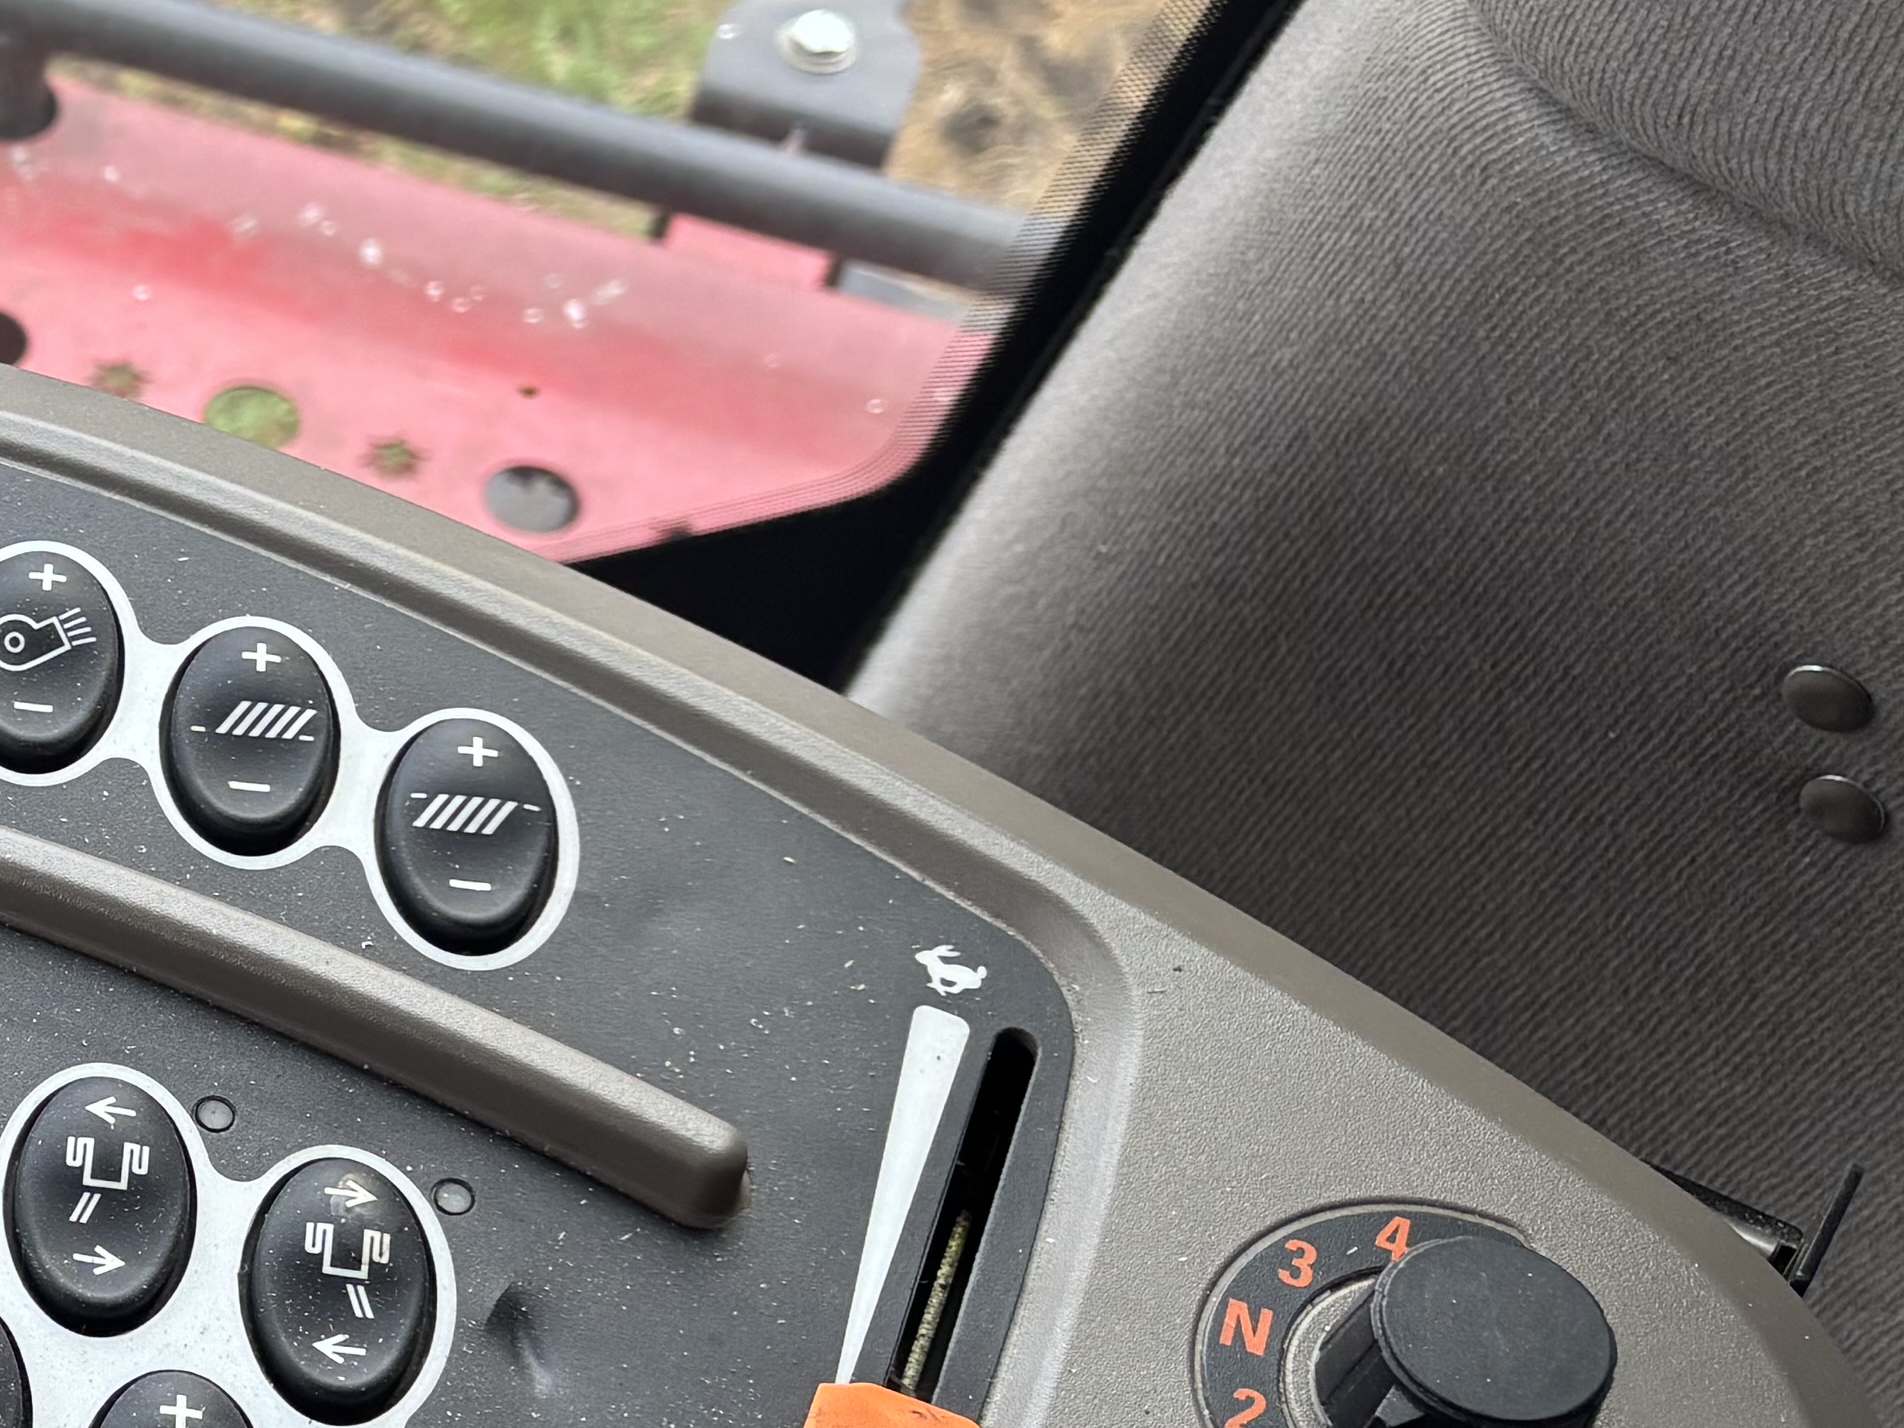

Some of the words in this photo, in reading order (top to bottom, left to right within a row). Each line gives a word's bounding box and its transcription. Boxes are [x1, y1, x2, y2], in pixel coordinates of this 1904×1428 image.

[1278, 1239, 1318, 1289] 3
[1375, 1215, 1412, 1263] 4
[1220, 1299, 1274, 1356] N
